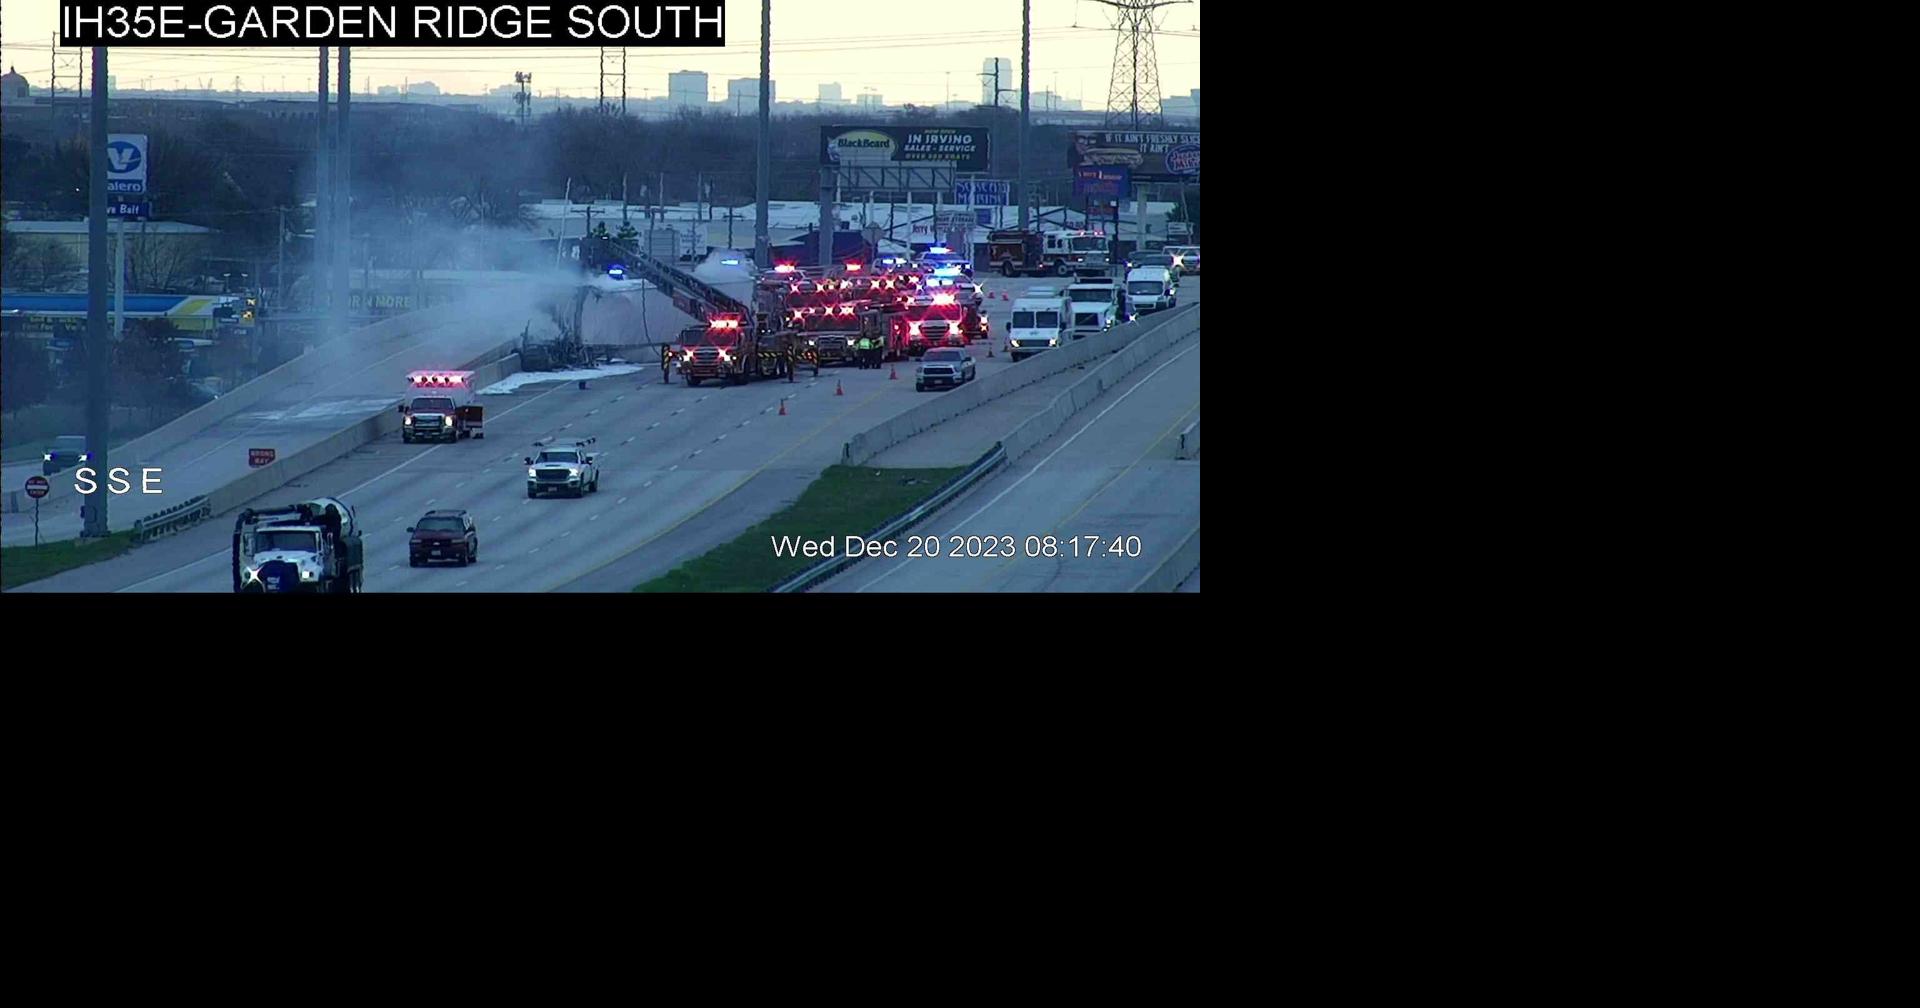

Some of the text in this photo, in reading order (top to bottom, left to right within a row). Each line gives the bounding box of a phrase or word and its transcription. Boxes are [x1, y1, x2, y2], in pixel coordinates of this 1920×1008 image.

[908, 134, 972, 144] IN IRVING
[904, 144, 931, 152] SALES
[107, 181, 142, 192] alero
